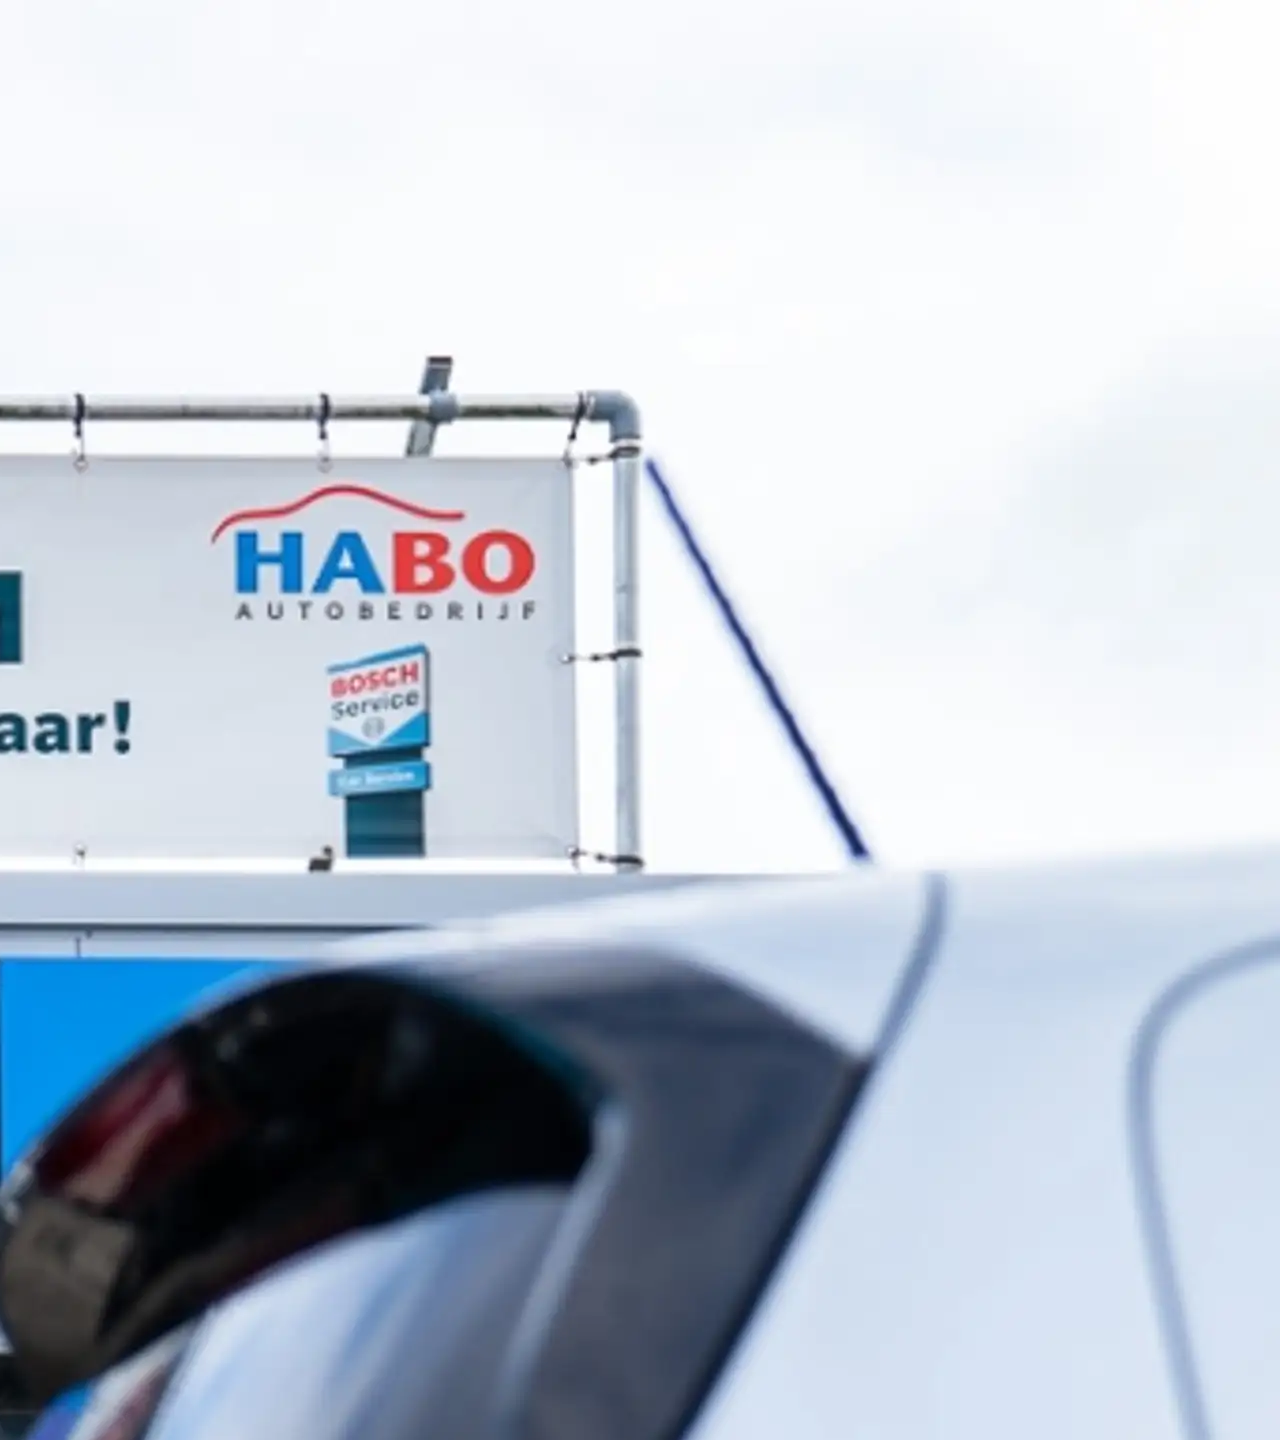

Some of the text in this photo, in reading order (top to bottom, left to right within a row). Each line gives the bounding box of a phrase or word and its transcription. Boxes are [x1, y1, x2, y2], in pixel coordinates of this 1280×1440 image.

[236, 530, 535, 595] HABO
[235, 600, 537, 621] AUTOBEDRIJF
[330, 661, 419, 698] BOSCH
[330, 690, 419, 720] Service
